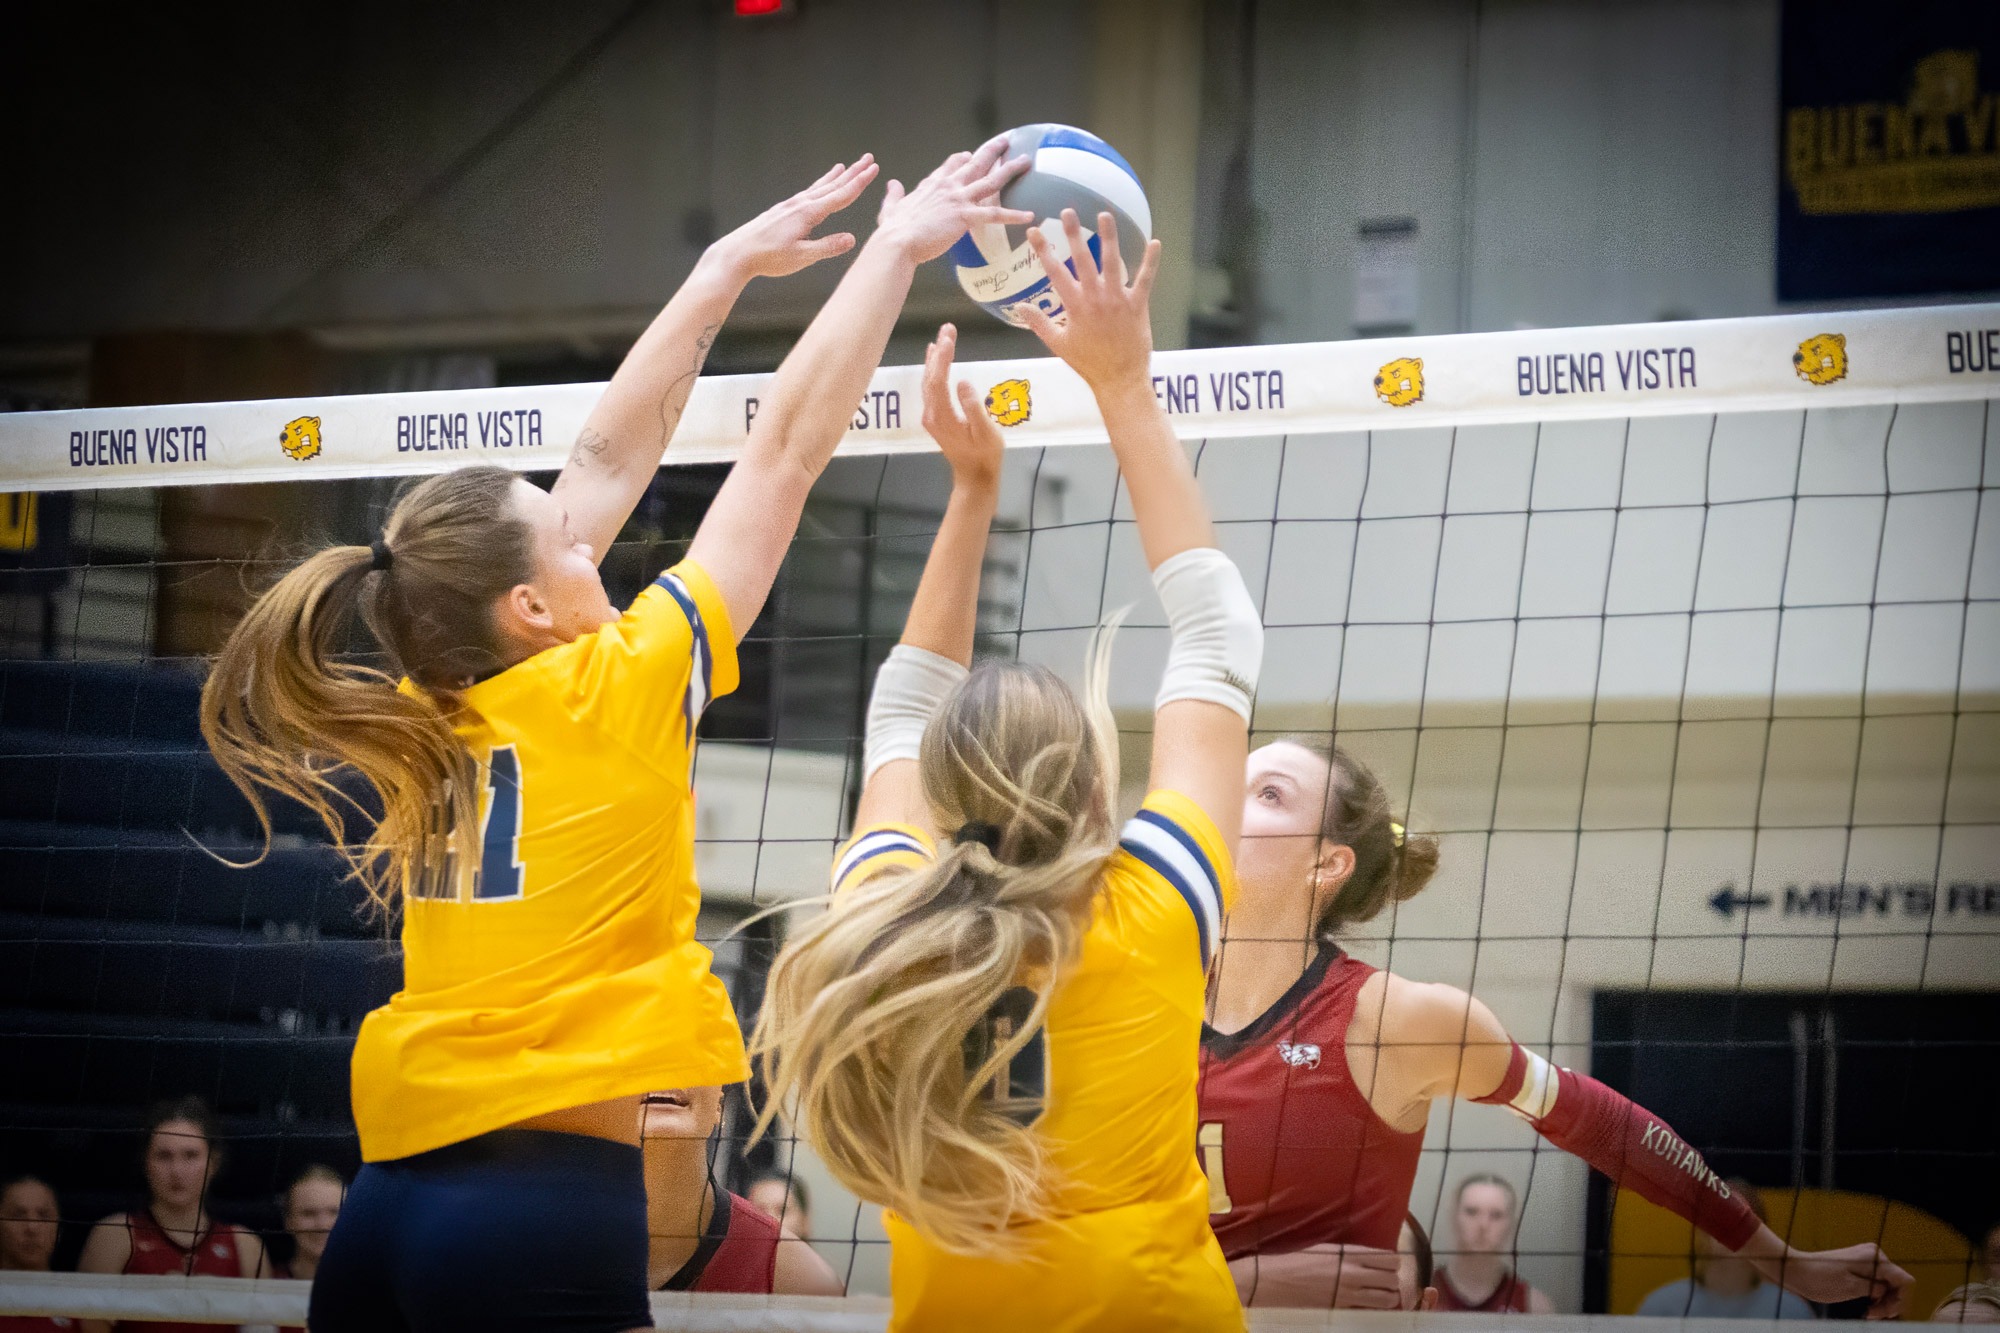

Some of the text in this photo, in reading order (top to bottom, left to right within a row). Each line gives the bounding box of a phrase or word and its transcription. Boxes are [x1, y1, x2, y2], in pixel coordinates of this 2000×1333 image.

[1152, 370, 1285, 414] ENA VISTA
[1517, 346, 1697, 396] BUENA VISTA
[397, 408, 542, 452] BUENA VISTA
[850, 390, 901, 430] STA
[69, 425, 207, 467] BUENA VISTA
[1641, 1121, 1731, 1199] KOHAWKS
